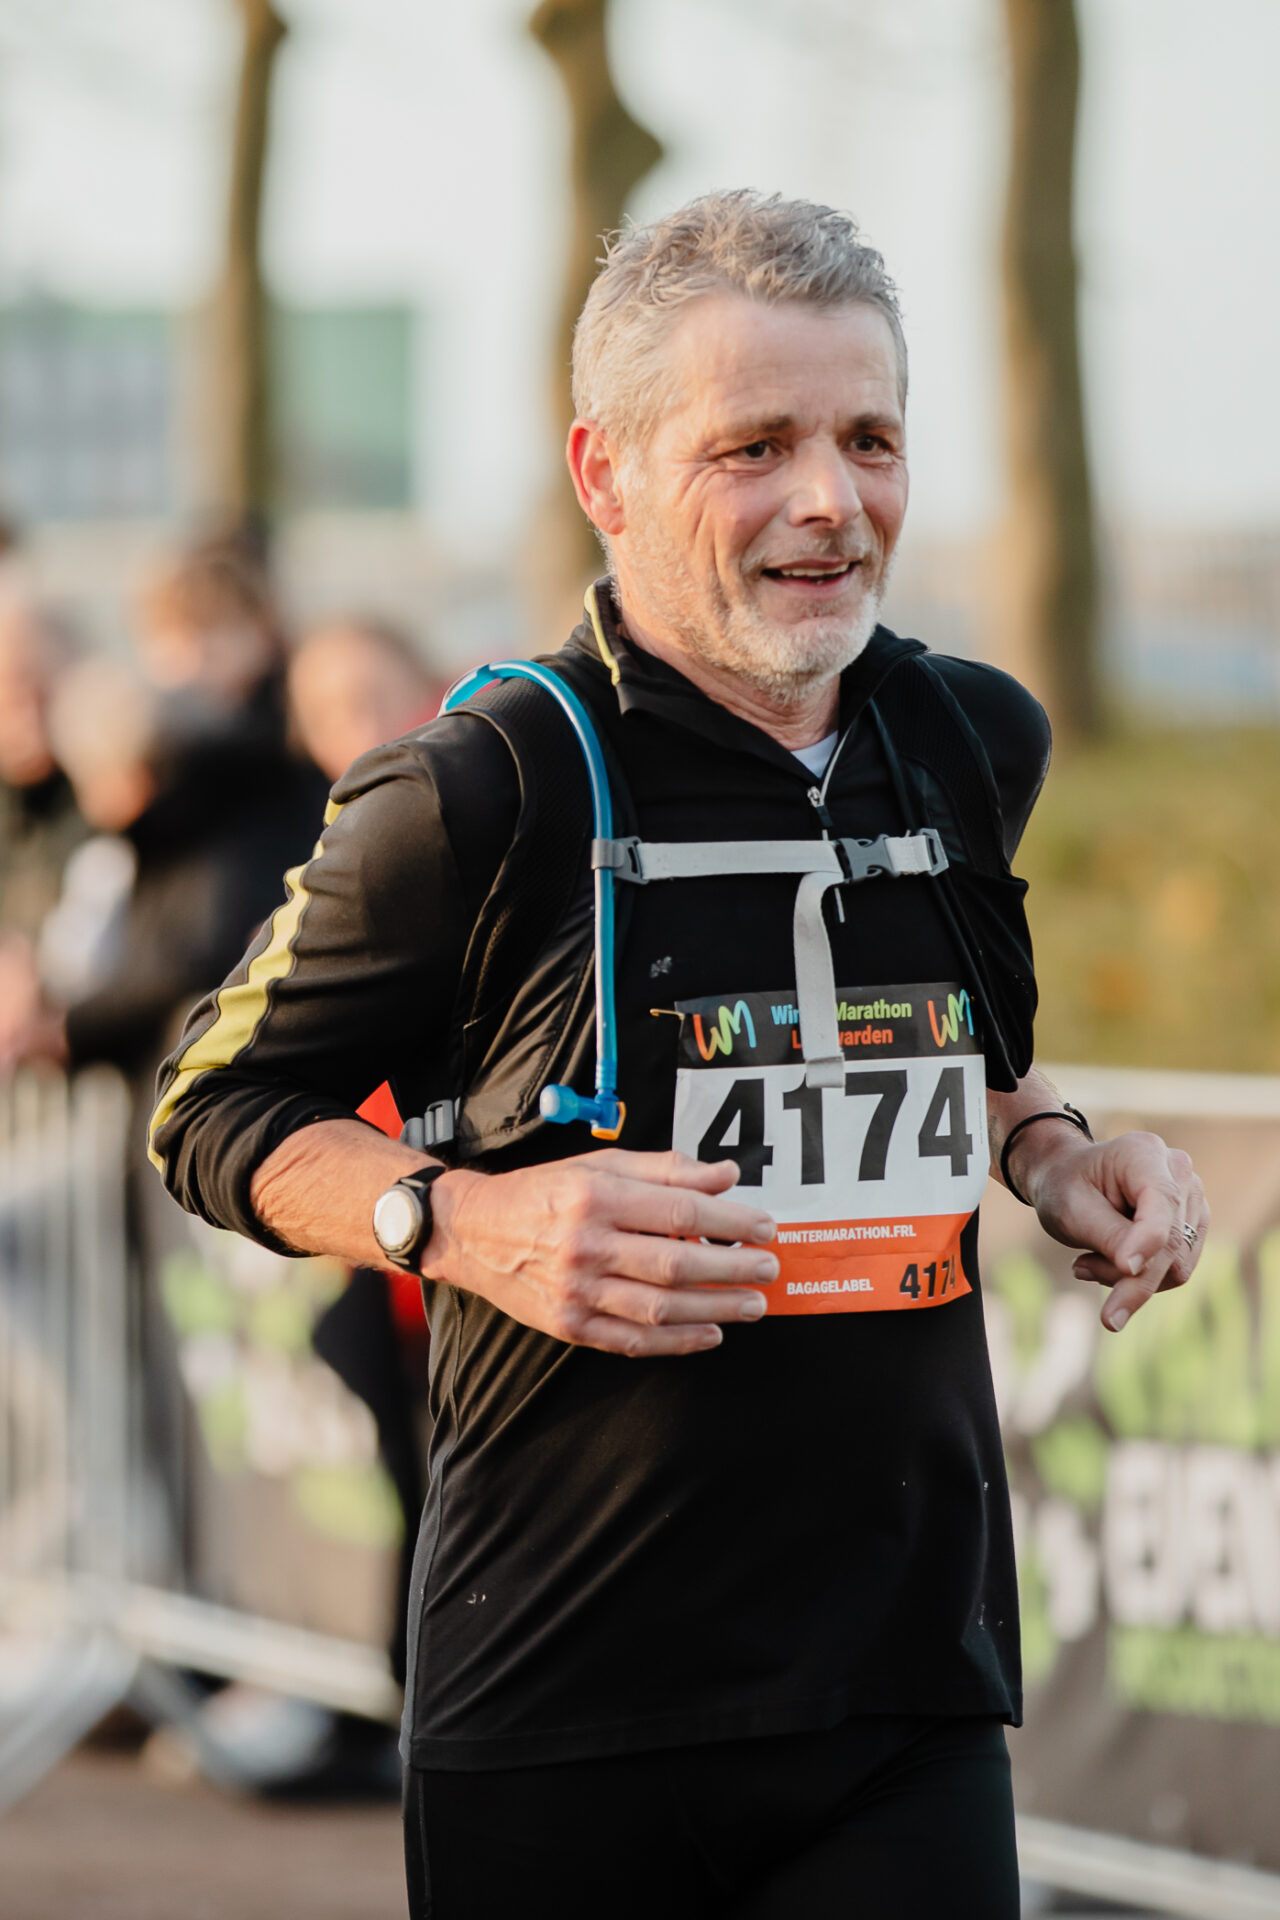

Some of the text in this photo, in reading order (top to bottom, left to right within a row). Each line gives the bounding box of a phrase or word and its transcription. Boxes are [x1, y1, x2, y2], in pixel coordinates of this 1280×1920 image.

[835, 998, 912, 1021] Marathon
[792, 1024, 893, 1049] Larden
[697, 1066, 974, 1187] 4174
[777, 1225, 916, 1244] WINTERMARATHON.FRL
[787, 1279, 874, 1295] BAGAGELABEL
